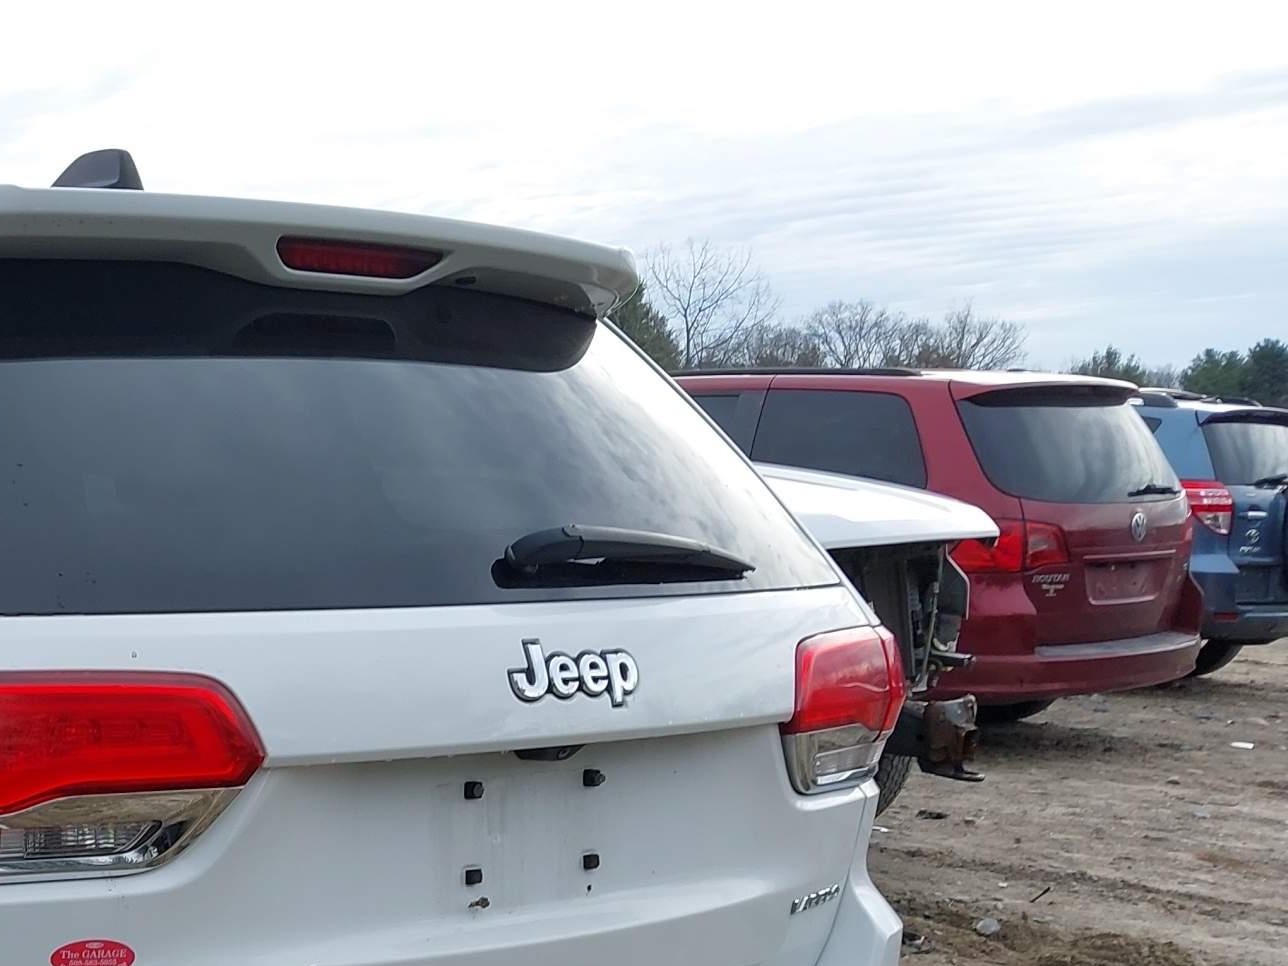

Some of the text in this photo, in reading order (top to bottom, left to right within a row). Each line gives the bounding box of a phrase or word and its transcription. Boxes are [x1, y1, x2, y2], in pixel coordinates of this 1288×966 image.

[506, 638, 640, 708] Jeep
[60, 948, 128, 960] The GARAGE
